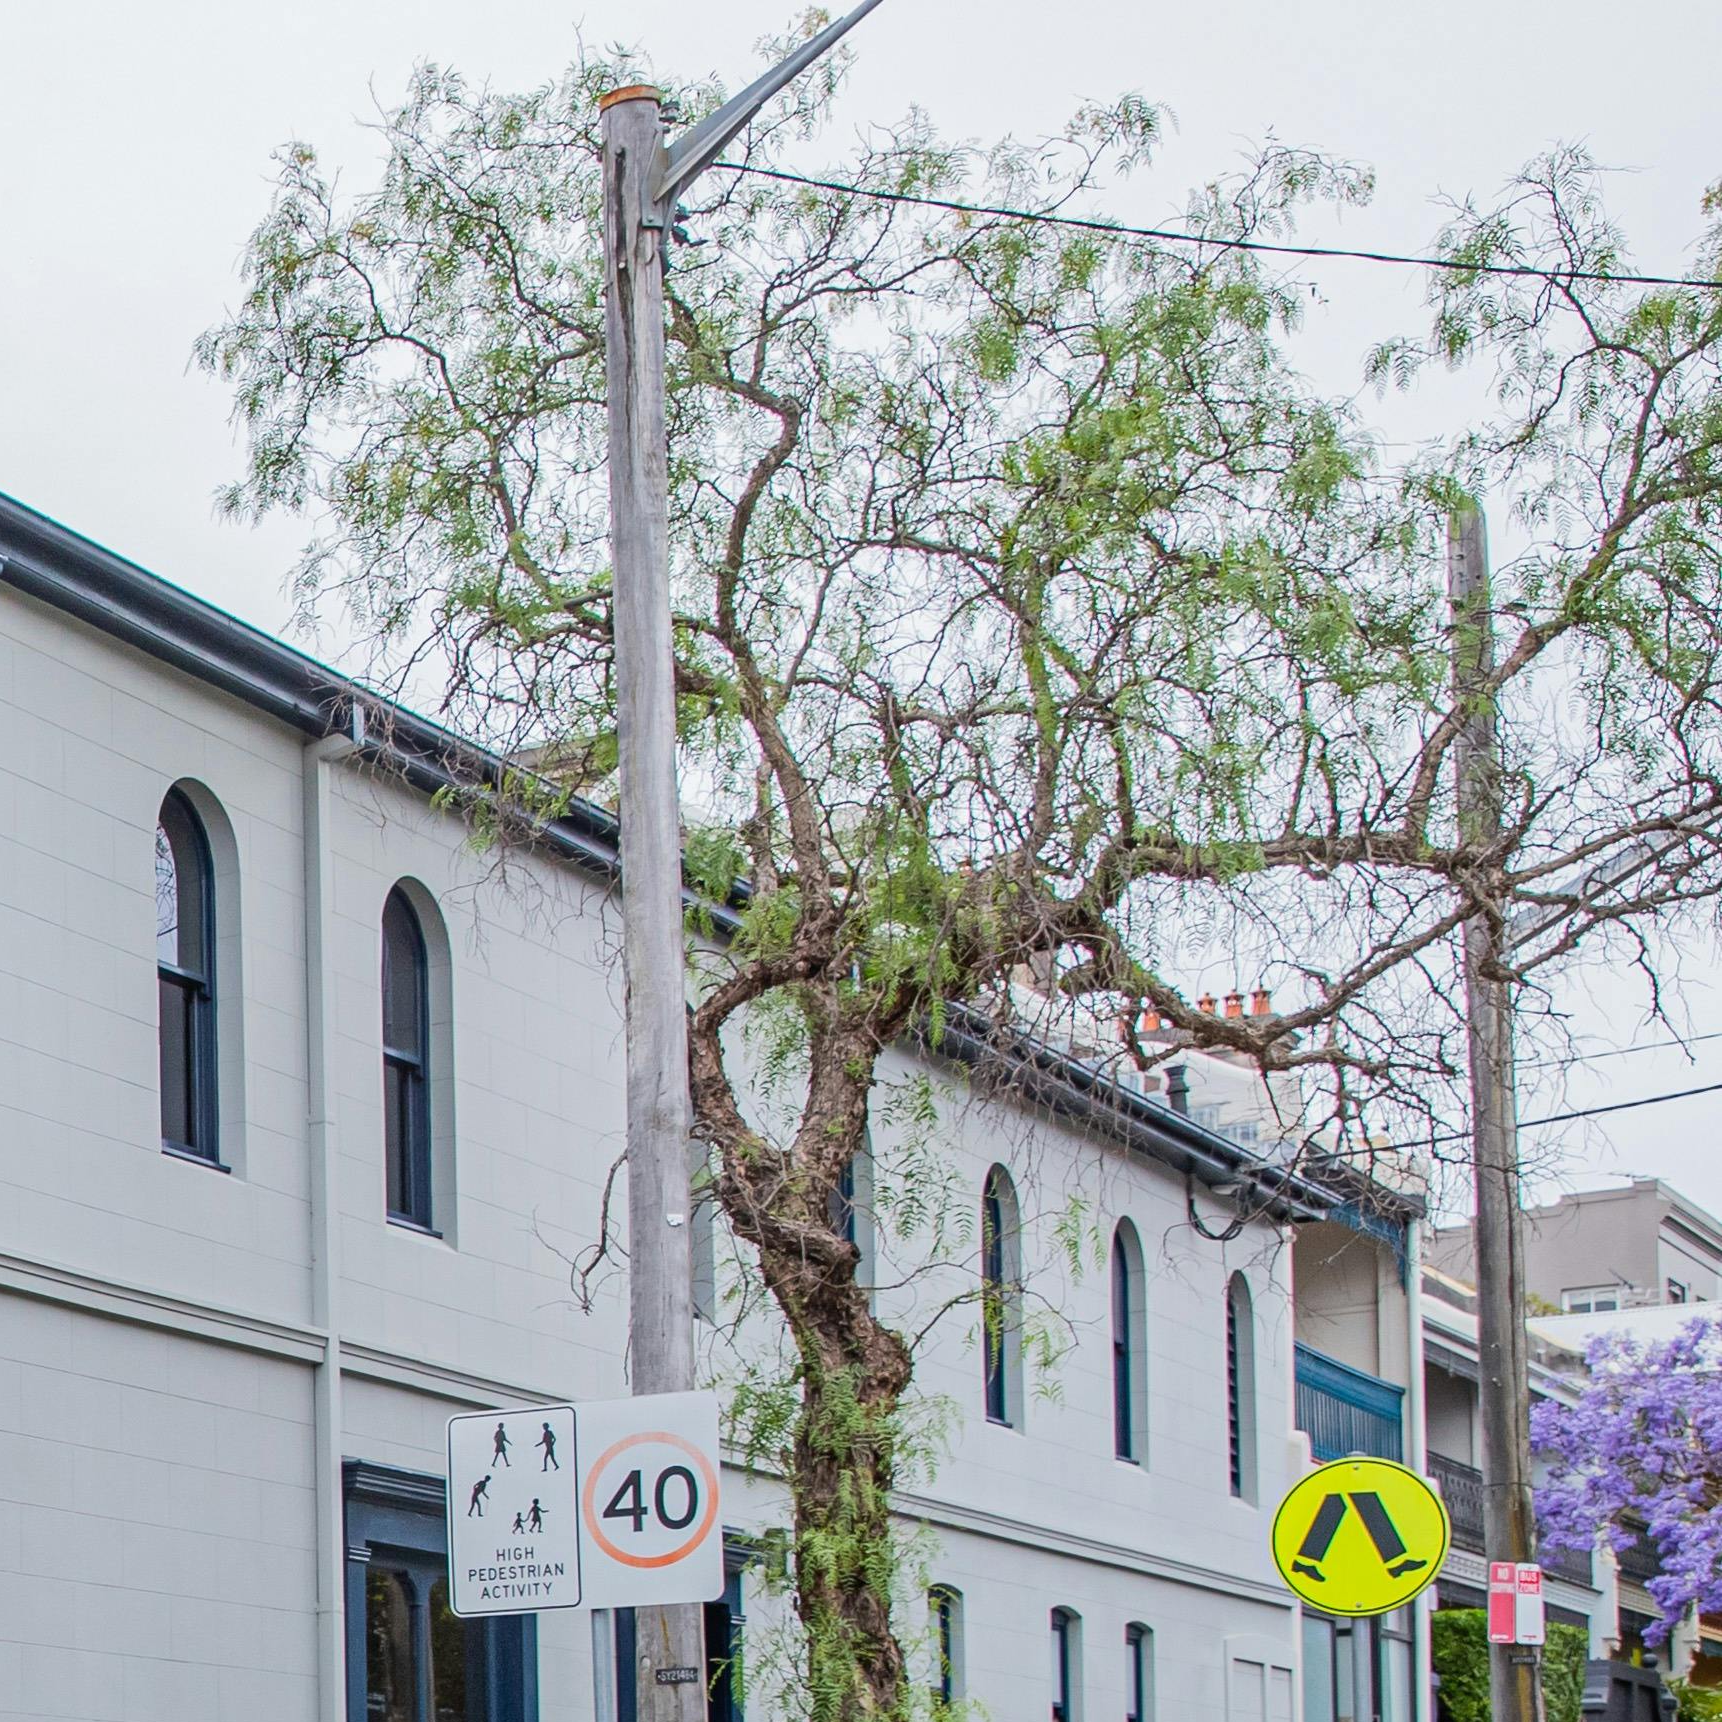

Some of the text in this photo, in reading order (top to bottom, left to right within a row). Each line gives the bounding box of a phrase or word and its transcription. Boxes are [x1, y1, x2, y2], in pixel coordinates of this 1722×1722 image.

[603, 1465, 698, 1532] 40
[496, 1547, 534, 1561] HIGH
[468, 1562, 564, 1582] PEDESTRIAN
[1519, 1571, 1538, 1582] BUS
[481, 1582, 553, 1599] ACTIVITY
